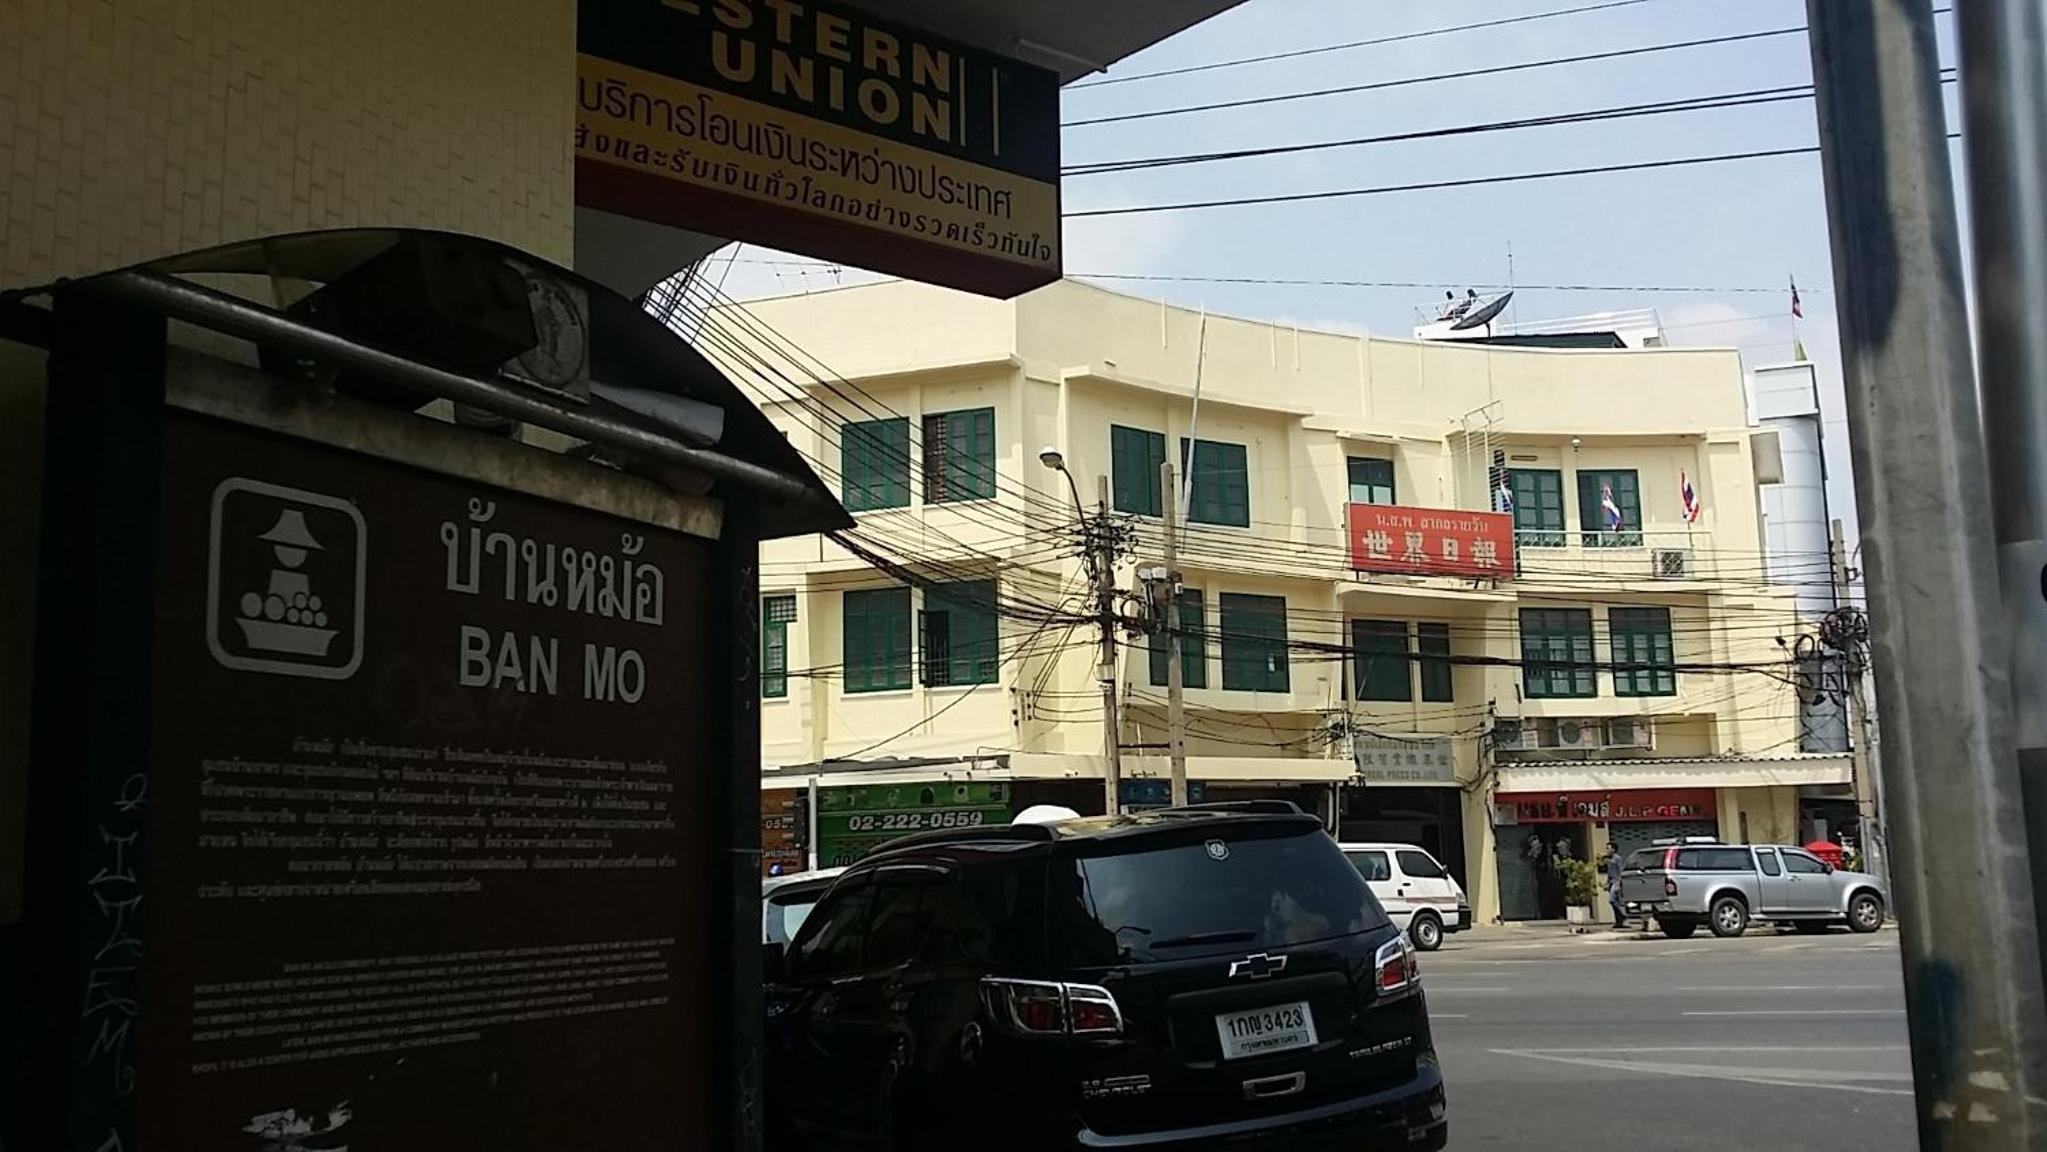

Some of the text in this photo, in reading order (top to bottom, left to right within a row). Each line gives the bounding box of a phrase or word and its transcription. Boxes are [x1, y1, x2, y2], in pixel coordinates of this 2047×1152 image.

[711, 31, 951, 142] UNION
[578, 77, 1013, 220] บริการโอนเงินระหว่างประเทศ
[439, 497, 665, 627] บ้านหม้อ
[1362, 529, 1502, 568] 世界日報
[459, 626, 647, 704] BAN MO
[848, 811, 983, 832] 02-222-0559
[1227, 1008, 1304, 1037] 1กญ 3423
